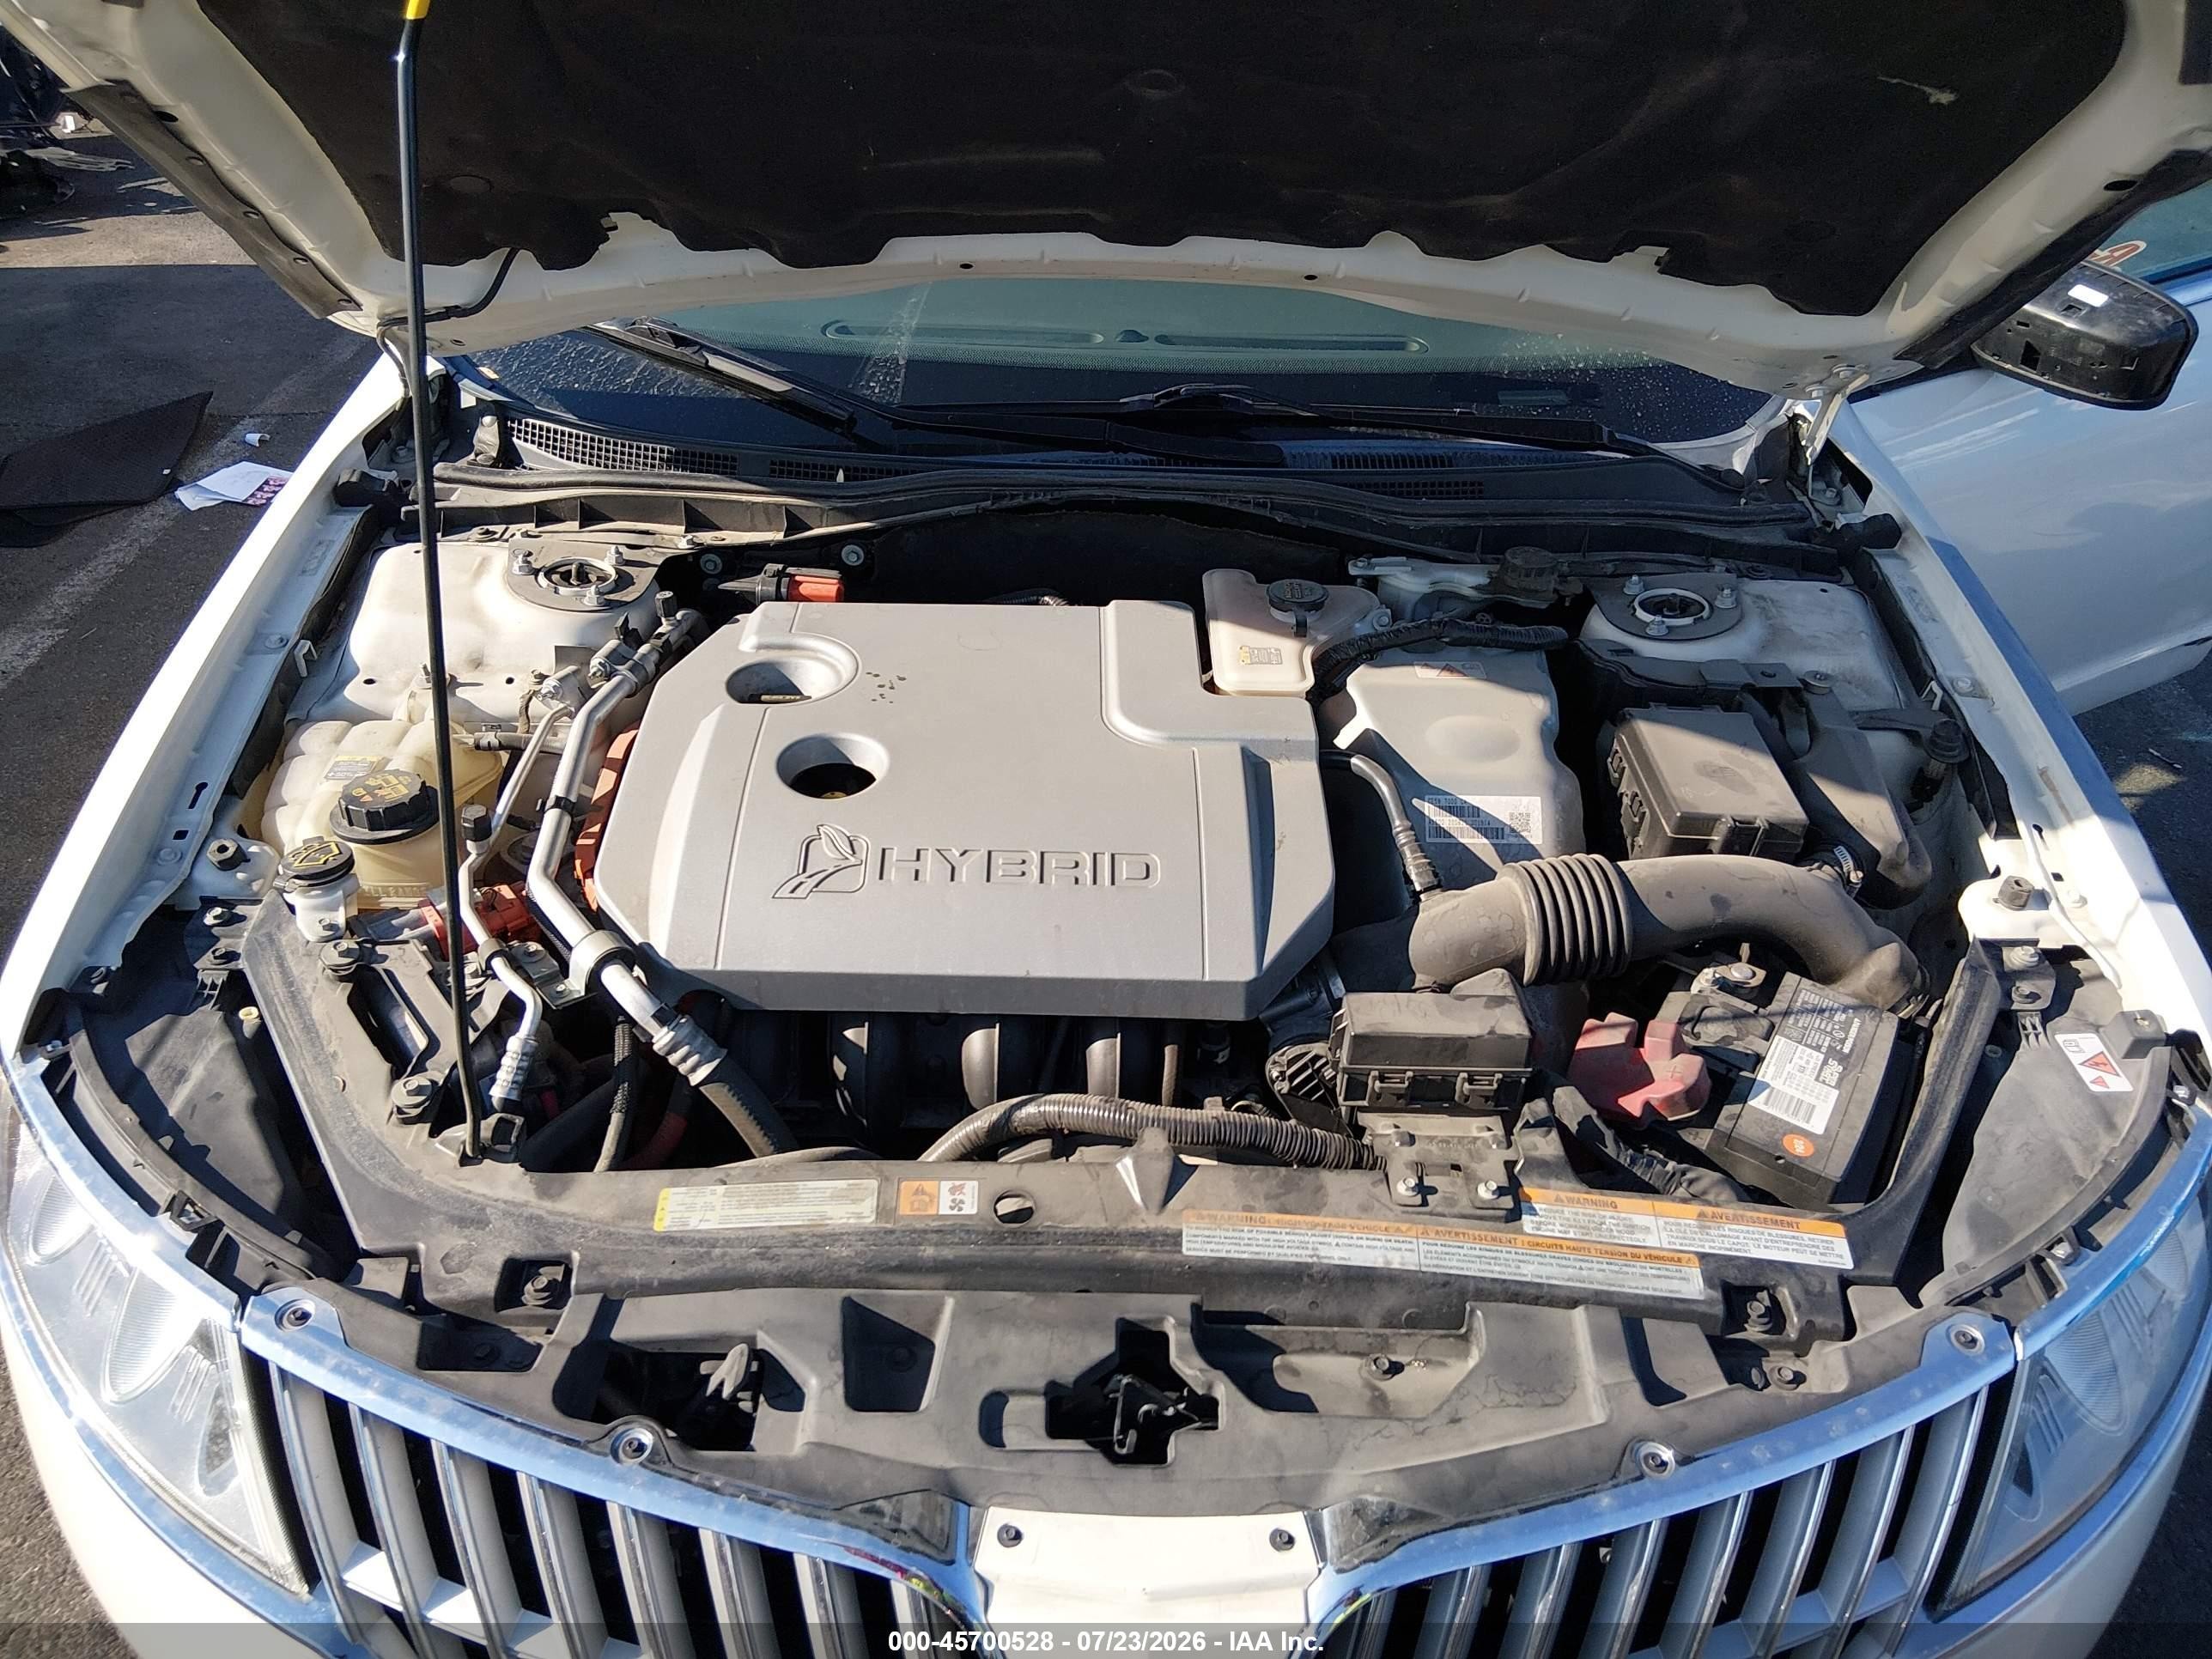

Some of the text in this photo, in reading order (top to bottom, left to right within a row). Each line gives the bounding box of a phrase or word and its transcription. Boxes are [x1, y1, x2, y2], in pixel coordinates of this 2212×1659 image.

[878, 847, 1161, 888] HYBRID
[1565, 1195, 1618, 1209] WARNING
[1711, 1211, 1800, 1230] AVERTISSEMENT
[1434, 1229, 1517, 1245] AVERTISSEMENT
[1526, 1240, 1565, 1250] CIRCUITS
[1565, 1244, 1591, 1253] HAUTE
[1593, 1247, 1628, 1257] TENSION
